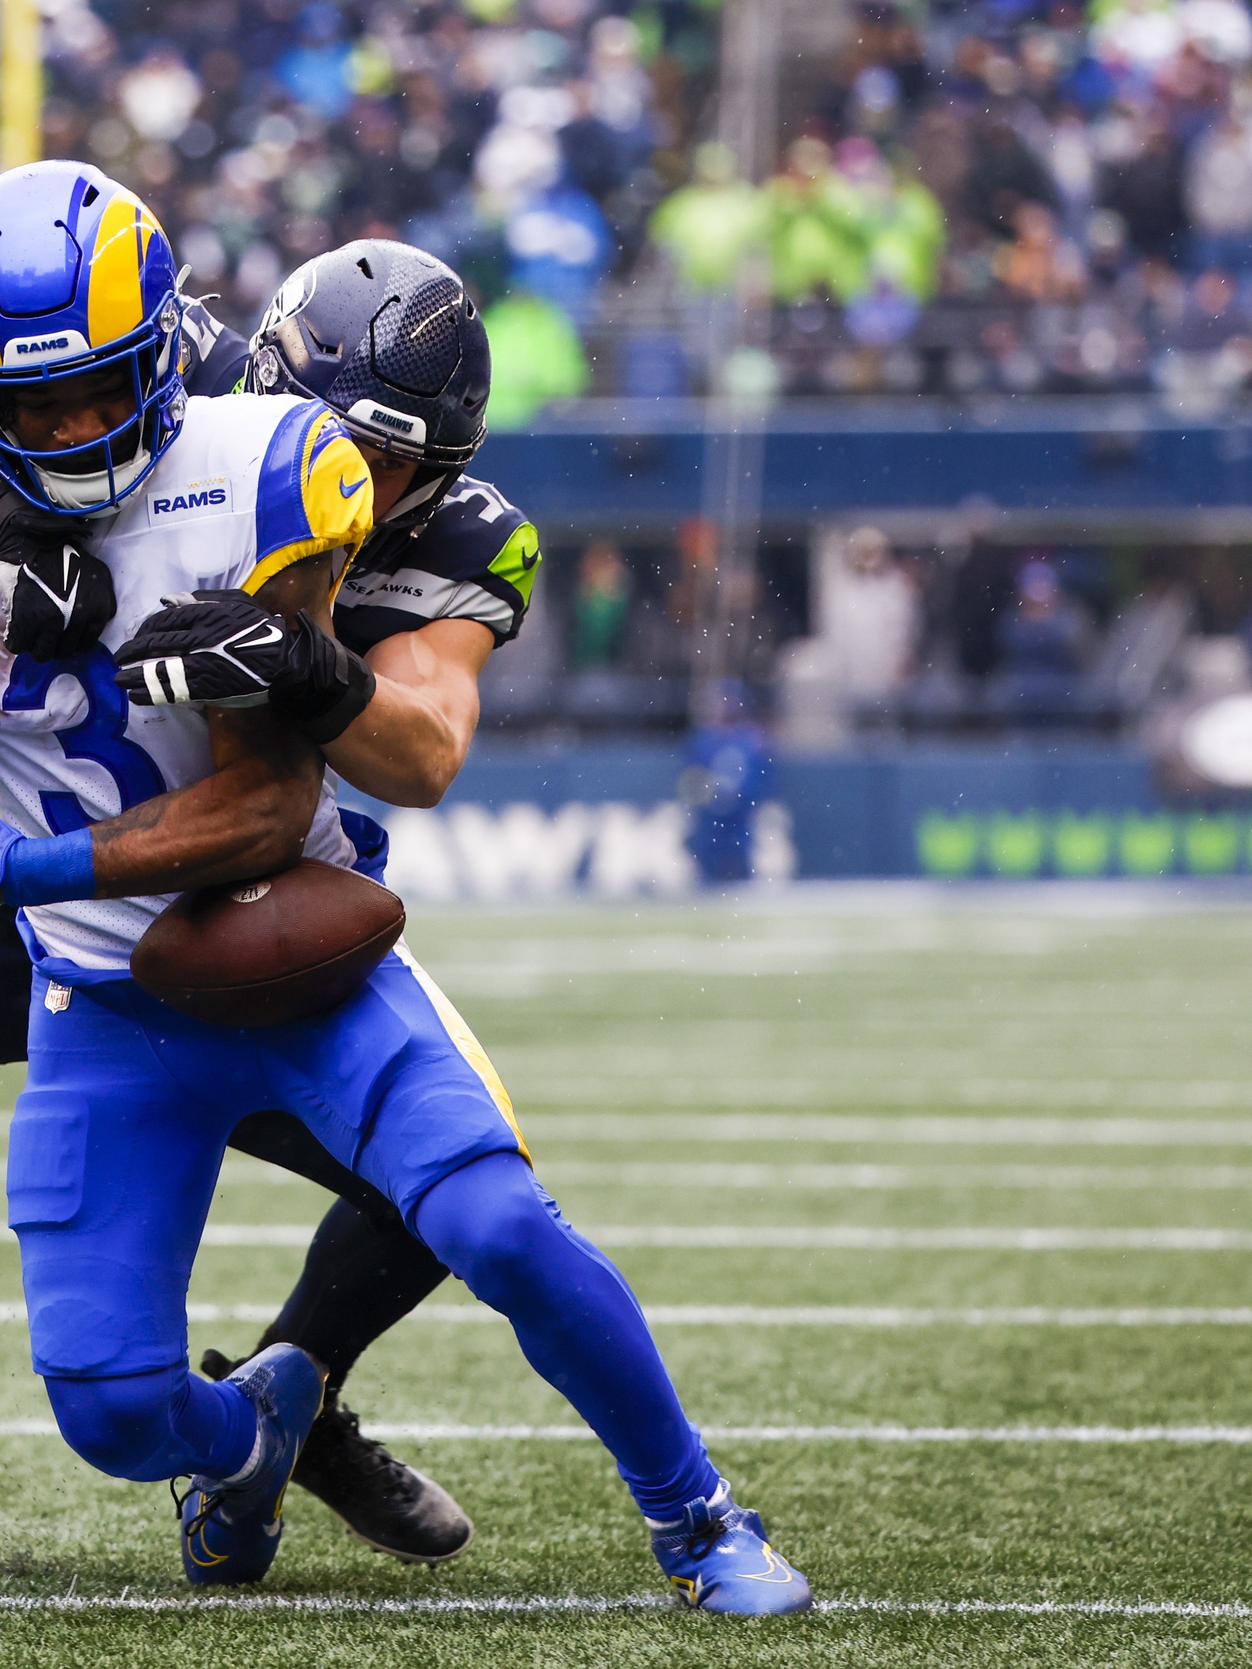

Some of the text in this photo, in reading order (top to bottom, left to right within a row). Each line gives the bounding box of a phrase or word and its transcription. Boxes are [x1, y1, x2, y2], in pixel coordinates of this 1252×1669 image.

[16, 337, 69, 354] RAMS
[370, 409, 414, 433] SEAHAWKS
[153, 489, 226, 515] RAMS
[2, 639, 168, 837] 3
